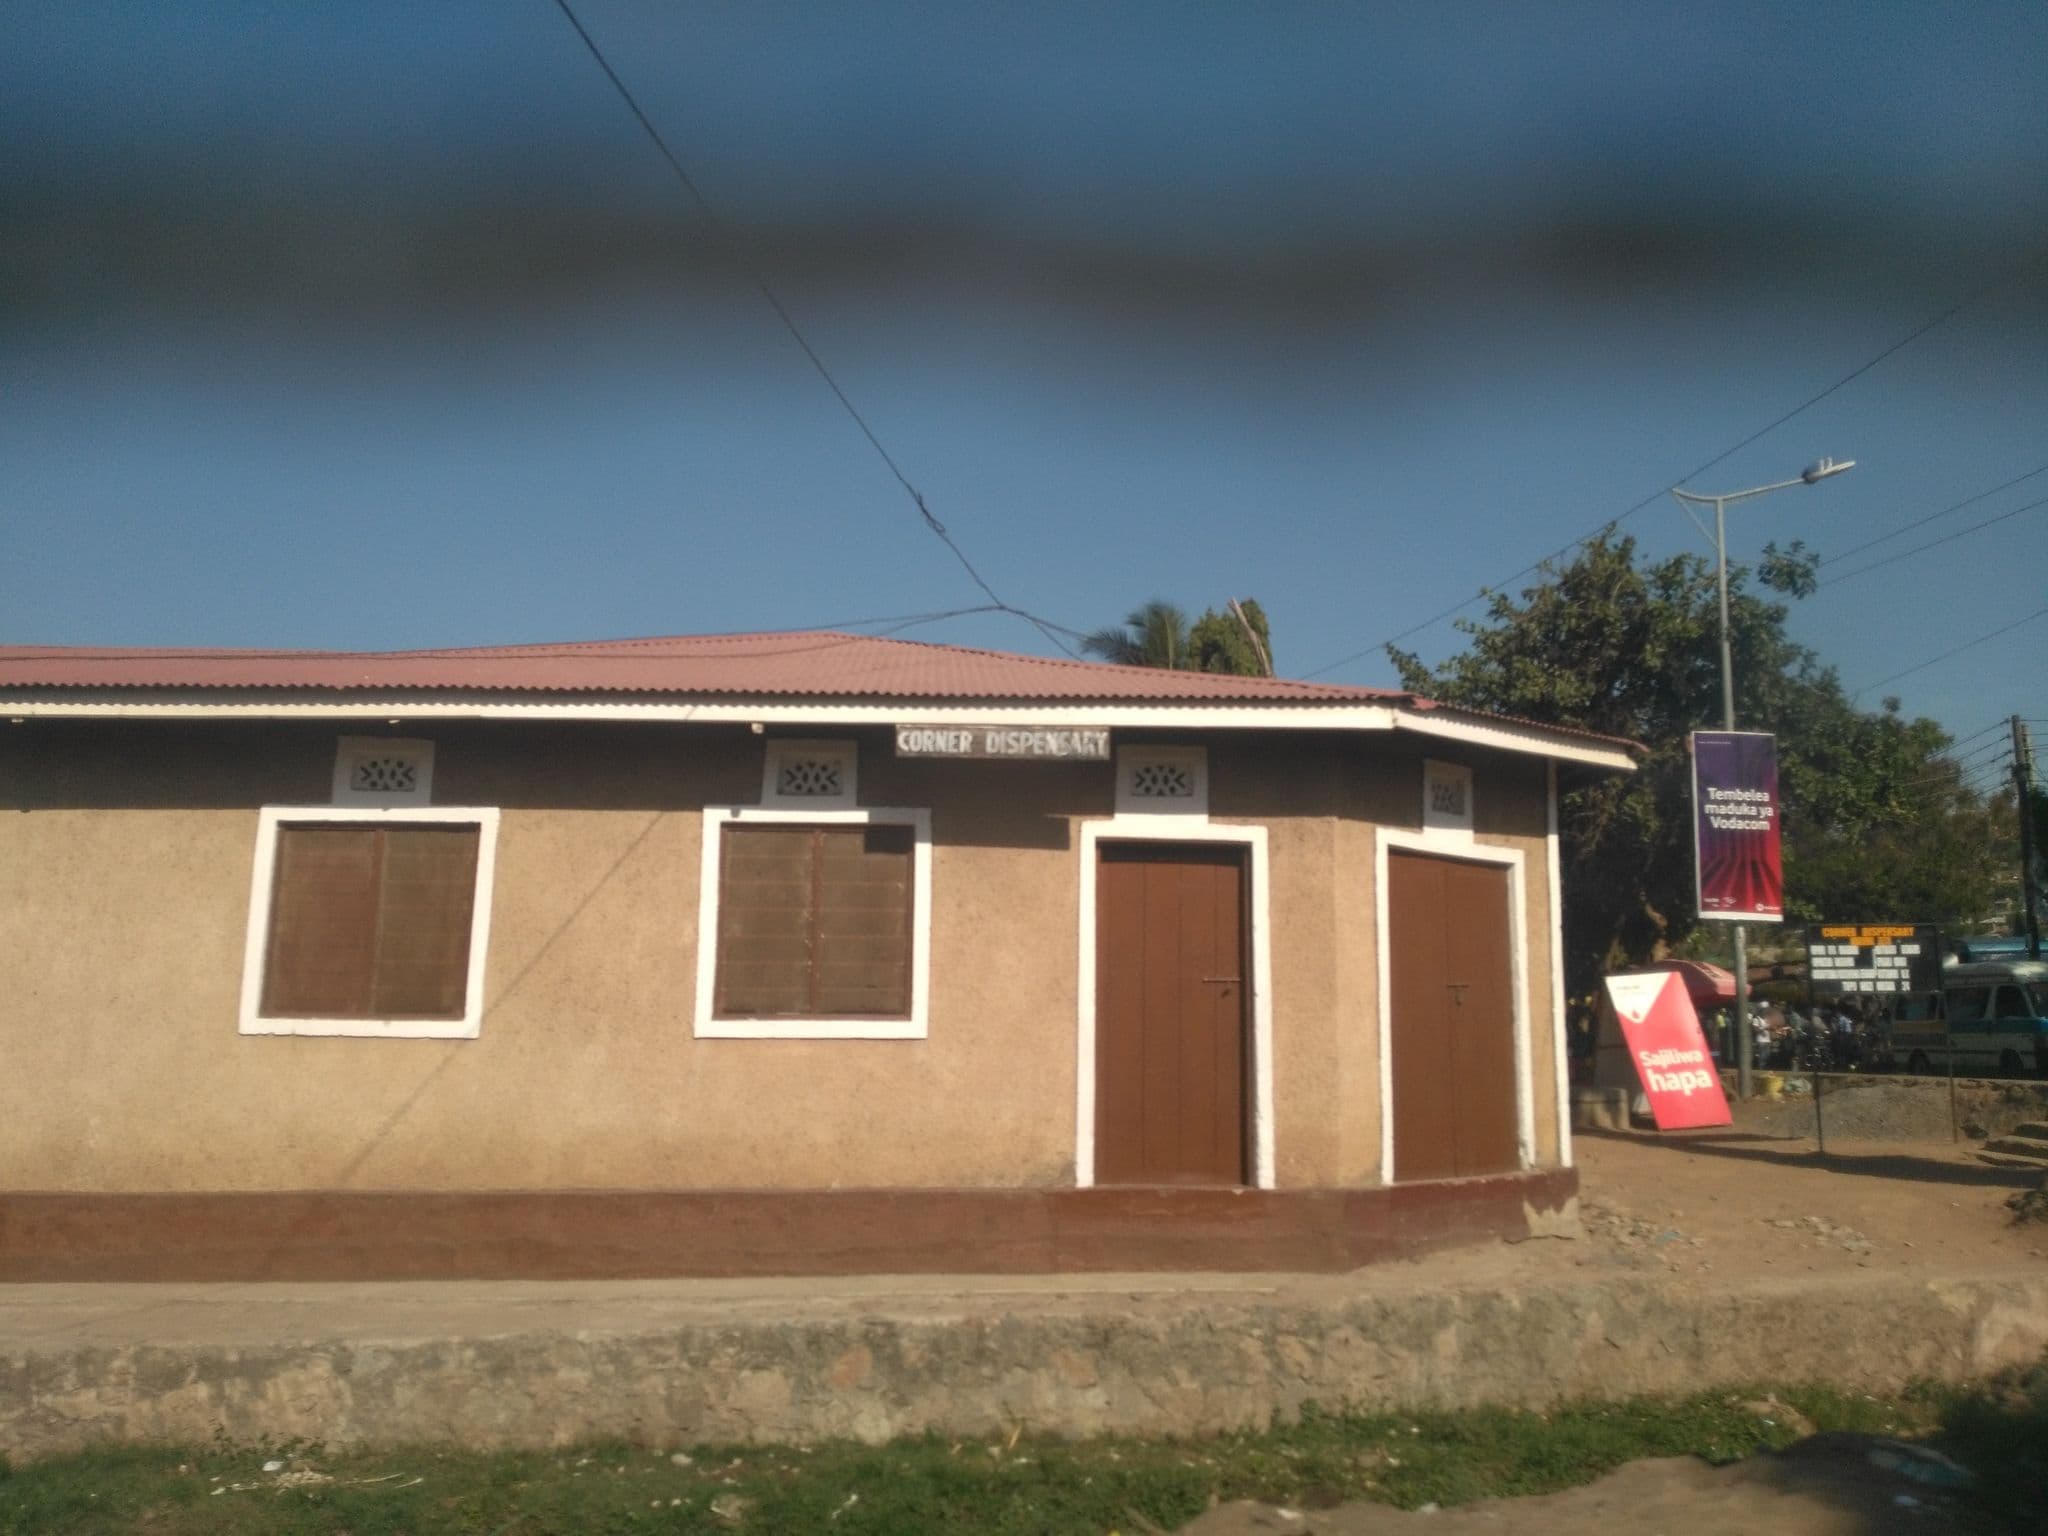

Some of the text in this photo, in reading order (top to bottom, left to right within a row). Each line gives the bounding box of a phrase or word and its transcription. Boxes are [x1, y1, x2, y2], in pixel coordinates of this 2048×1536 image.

[897, 730, 1108, 756] CORNER DISPENSARY
[1707, 787, 1770, 802] Tembelea
[1704, 803, 1774, 819] maduka ya
[1710, 816, 1770, 831] Vodacom
[1646, 1068, 1713, 1096] hapa
